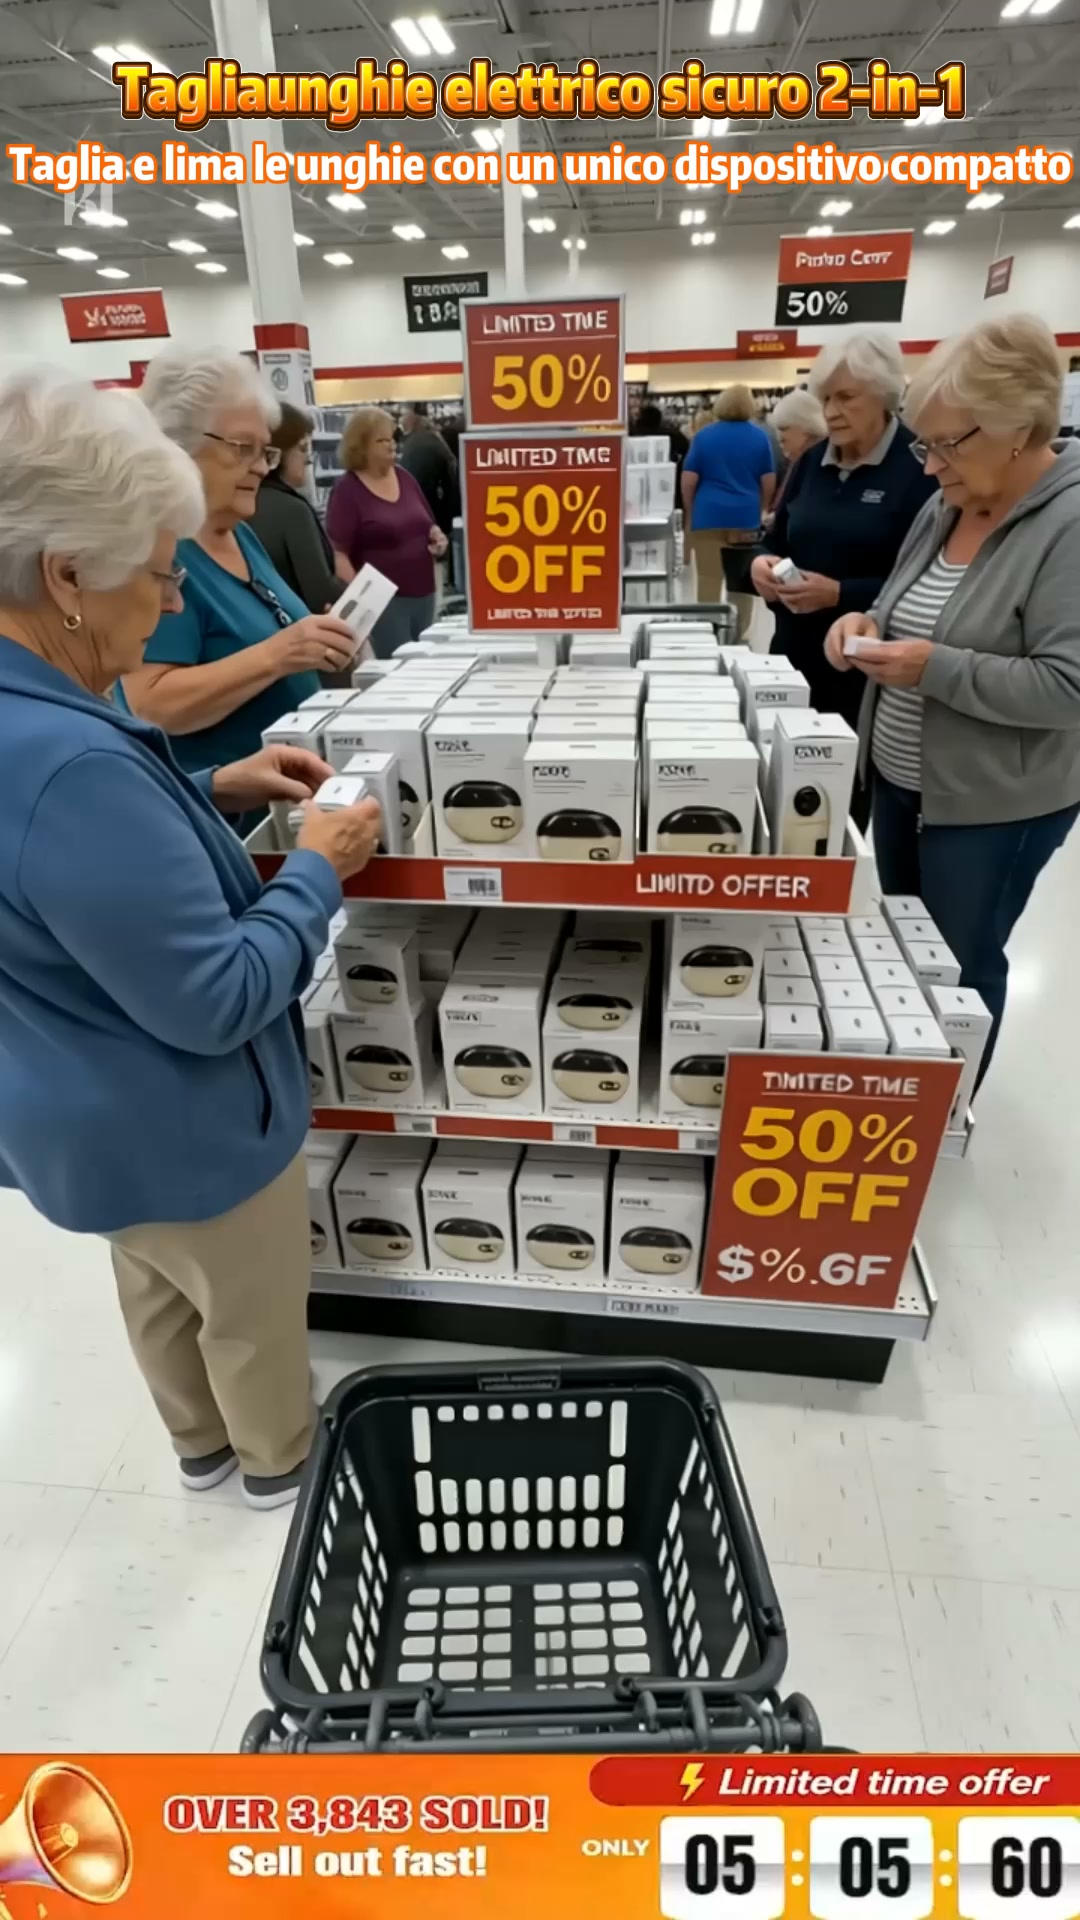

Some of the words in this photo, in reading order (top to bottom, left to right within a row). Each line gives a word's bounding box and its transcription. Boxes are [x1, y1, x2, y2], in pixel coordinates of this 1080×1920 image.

[787, 290, 848, 318] 50%
[491, 353, 612, 411] 50%
[485, 484, 607, 537] 50%
[485, 544, 606, 593] OFF
[721, 873, 811, 898] OFFER
[740, 1106, 918, 1165] 50%
[732, 1167, 909, 1222] OFF
